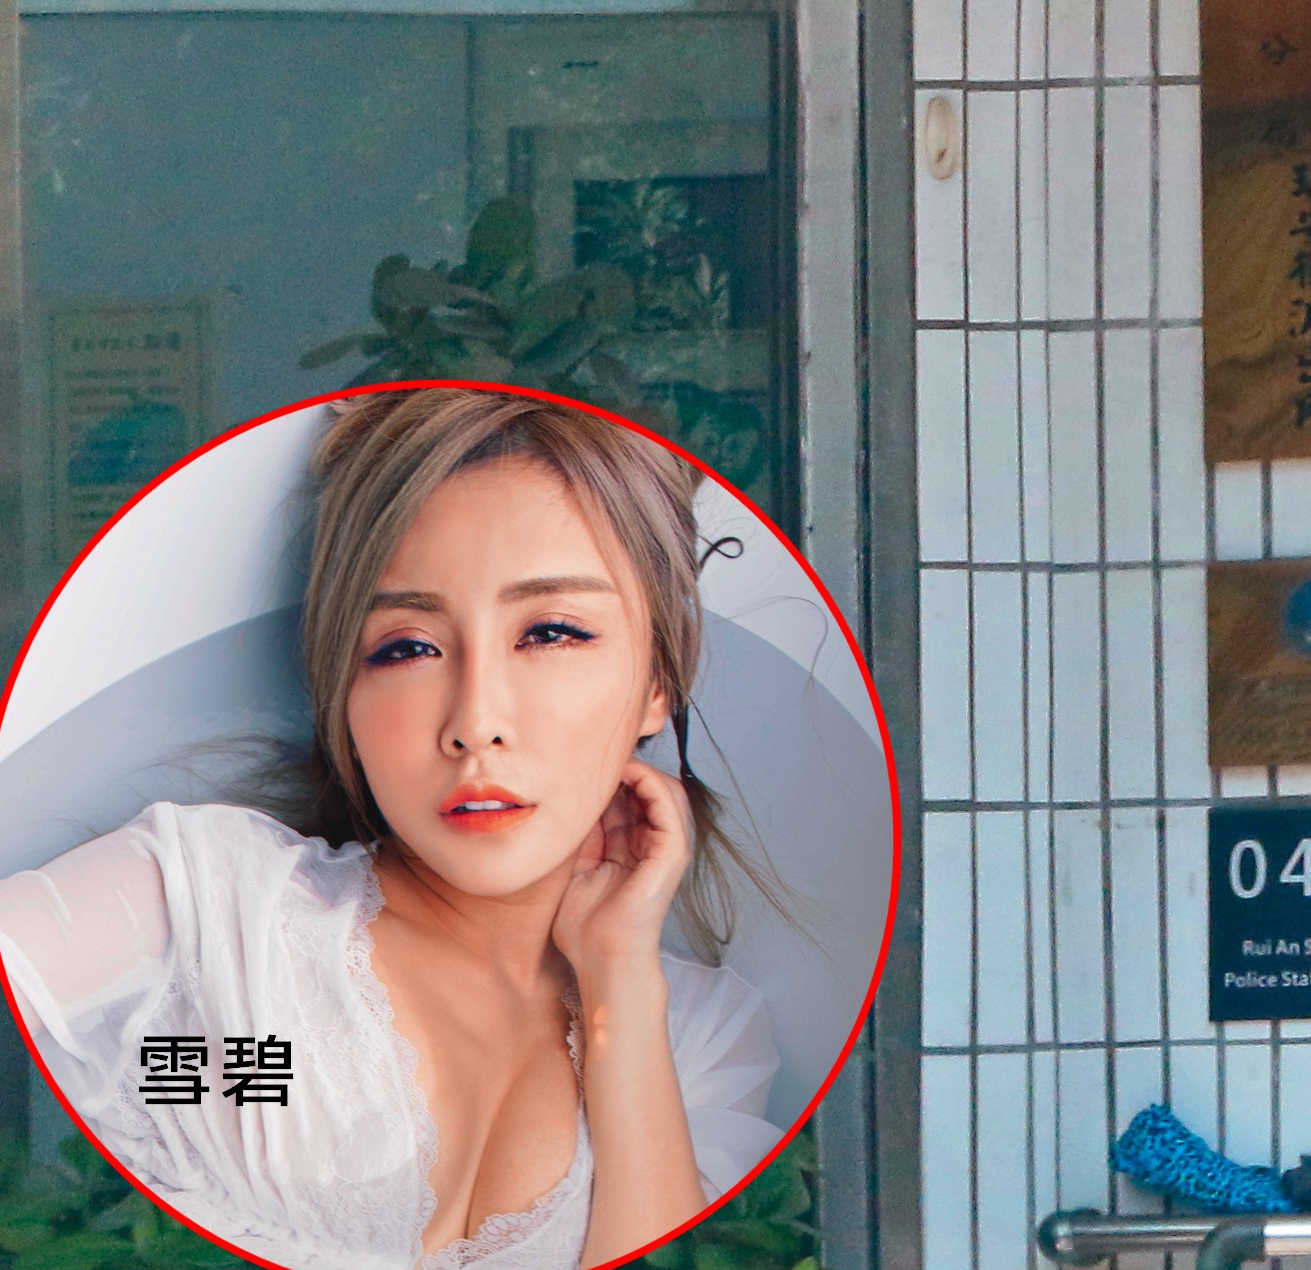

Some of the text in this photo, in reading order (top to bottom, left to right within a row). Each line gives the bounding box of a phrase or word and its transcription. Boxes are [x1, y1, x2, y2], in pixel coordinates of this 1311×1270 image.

[1241, 938, 1272, 956] Rui
[1275, 938, 1301, 956] An
[1224, 970, 1311, 988] Police Sta
